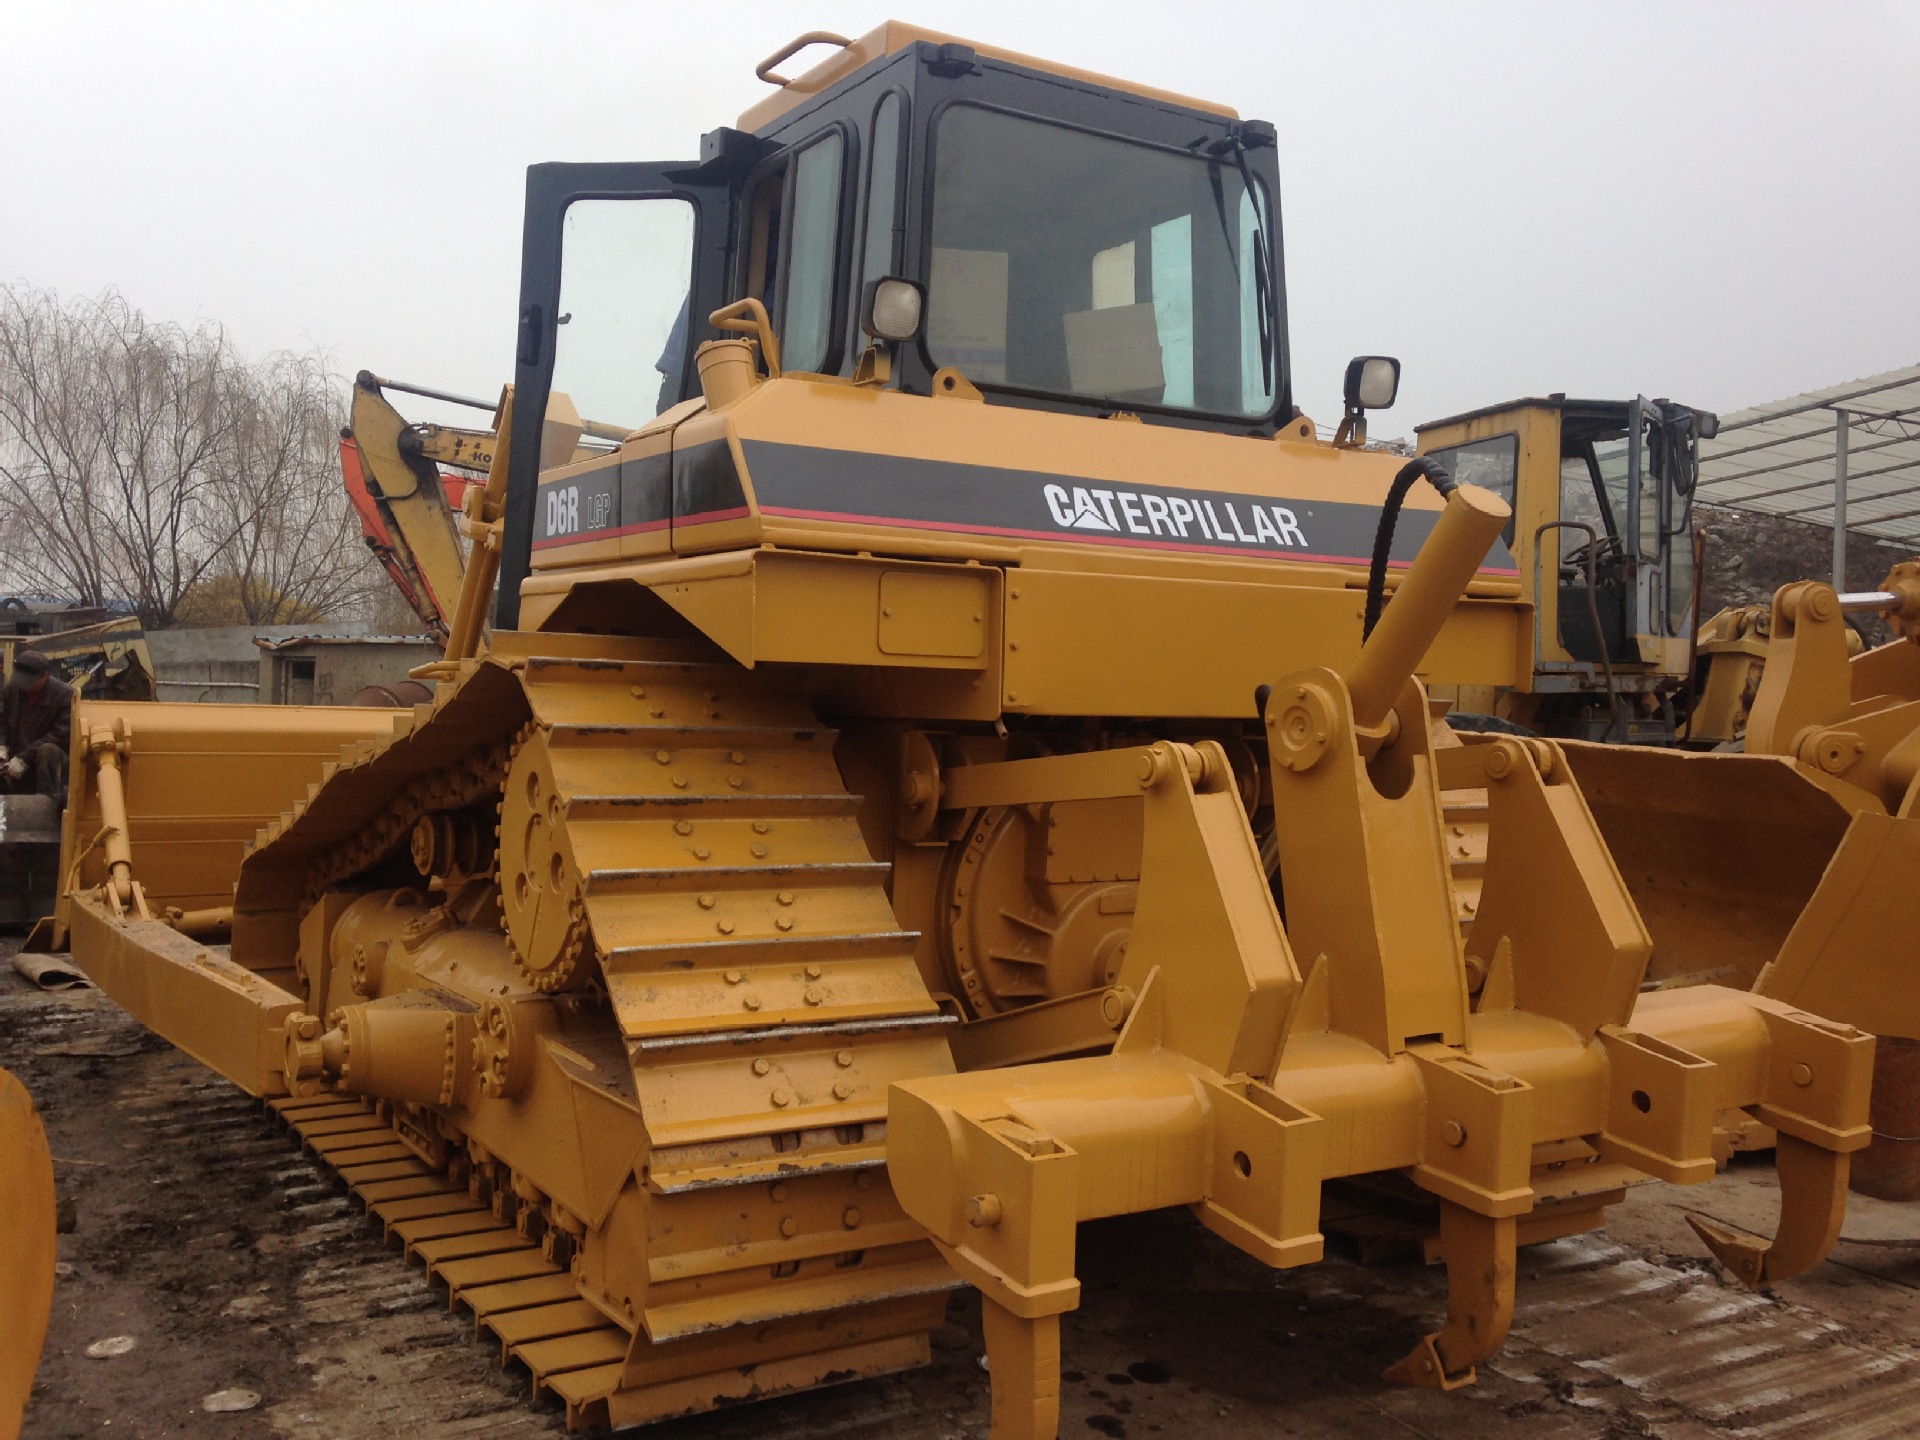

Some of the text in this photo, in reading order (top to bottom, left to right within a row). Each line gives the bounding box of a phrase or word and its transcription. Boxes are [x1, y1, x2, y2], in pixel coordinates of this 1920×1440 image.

[547, 486, 611, 536] D6R LGP
[1043, 483, 1309, 547] CATERPILLAR
